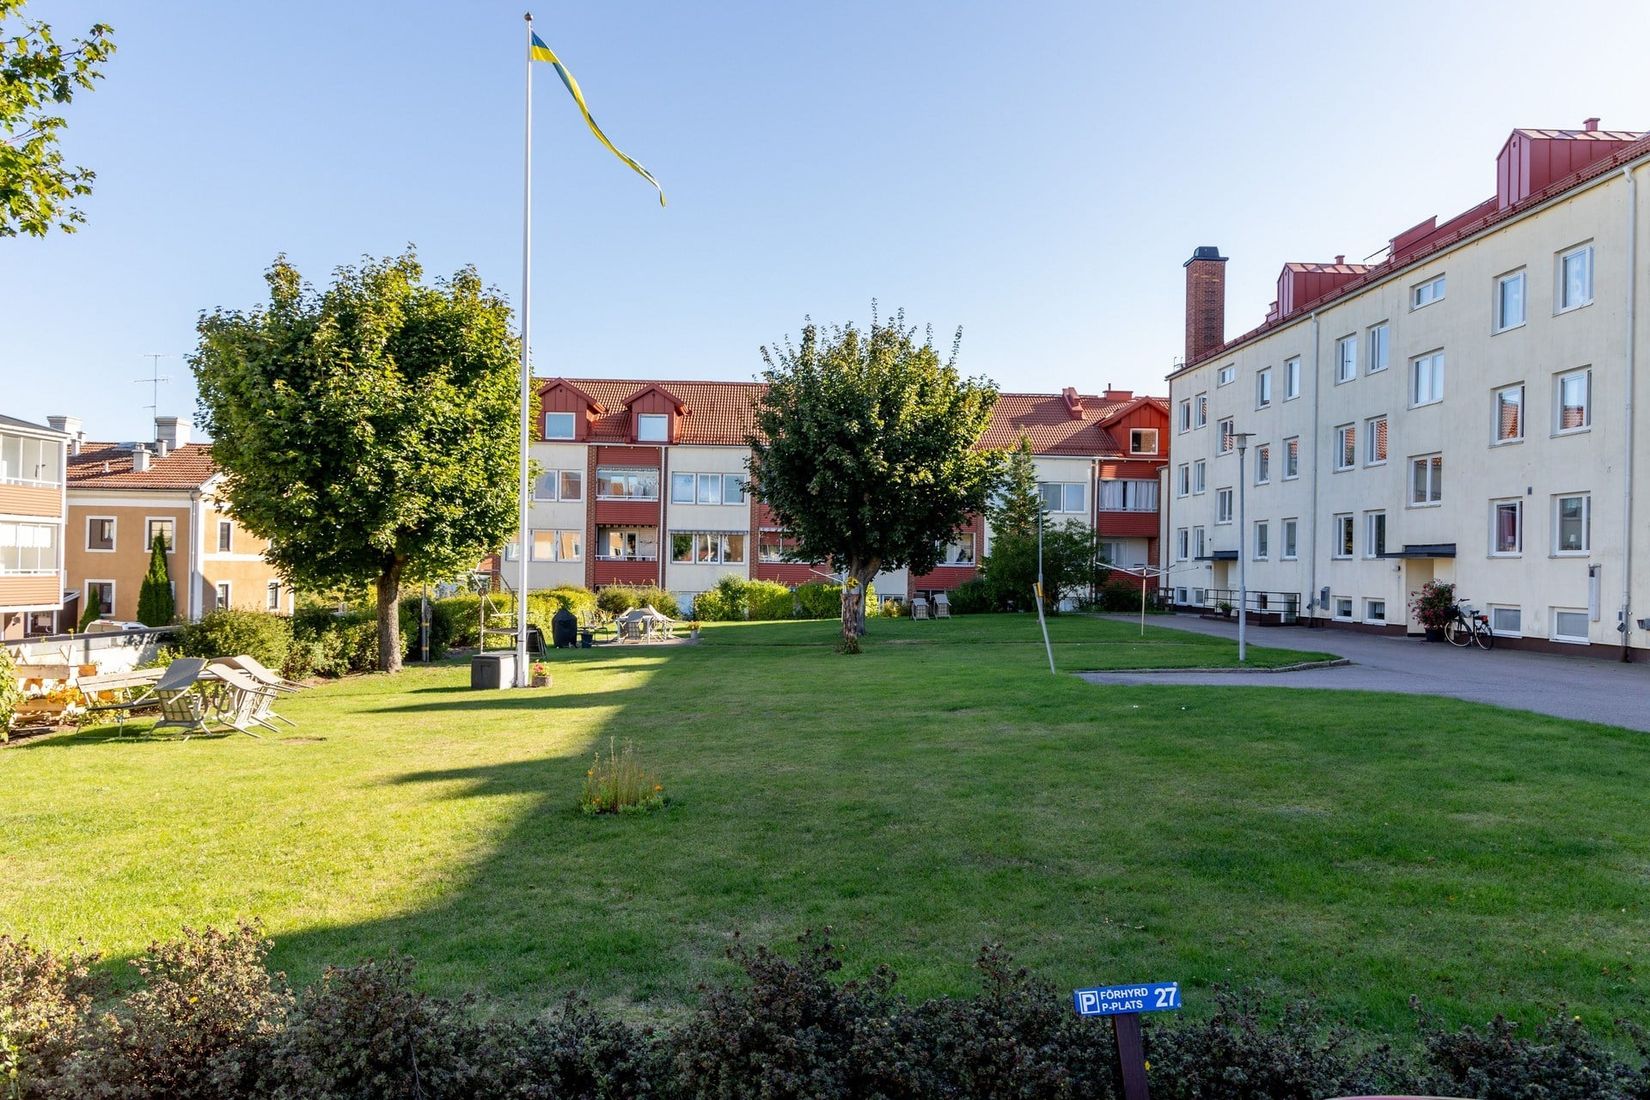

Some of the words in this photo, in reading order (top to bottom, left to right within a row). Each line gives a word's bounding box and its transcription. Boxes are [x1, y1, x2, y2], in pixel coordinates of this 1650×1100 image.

[1100, 987, 1148, 1000] FÖRHYRD
[1154, 987, 1177, 1008] 27
[1082, 994, 1096, 1012] P
[1101, 1000, 1143, 1012] P-PLATS
